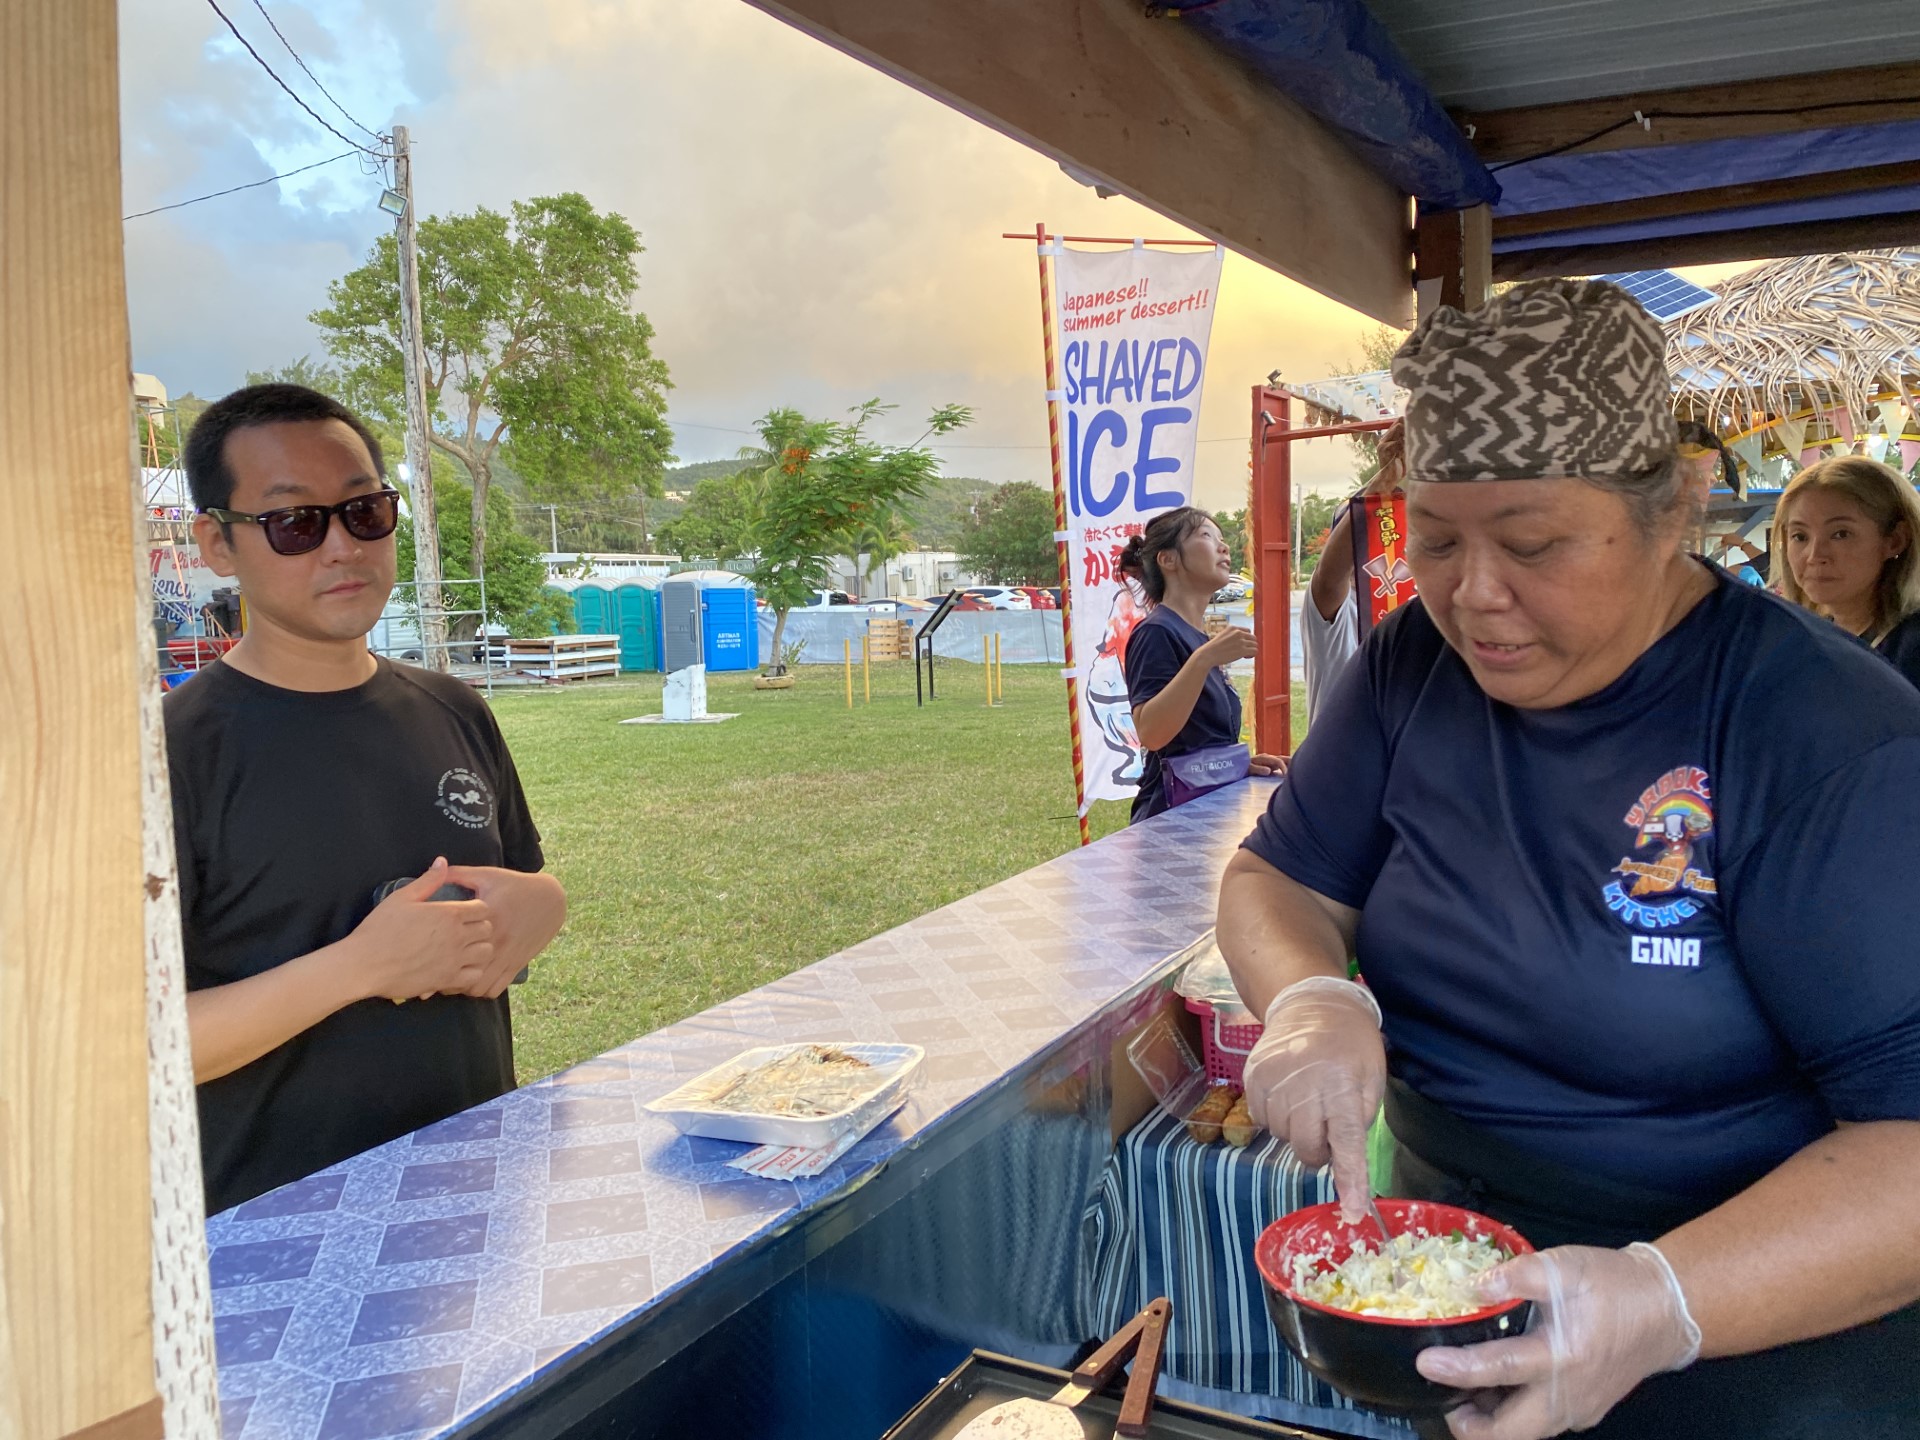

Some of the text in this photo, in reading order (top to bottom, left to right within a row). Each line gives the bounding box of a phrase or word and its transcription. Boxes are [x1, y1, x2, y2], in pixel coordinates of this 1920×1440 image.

[1063, 278, 1149, 315] Japanese!!
[1064, 289, 1209, 333] summer dessert!!
[1065, 337, 1202, 405] SHAVED
[1067, 407, 1192, 517] ICE
[1632, 936, 1701, 966] GINA
